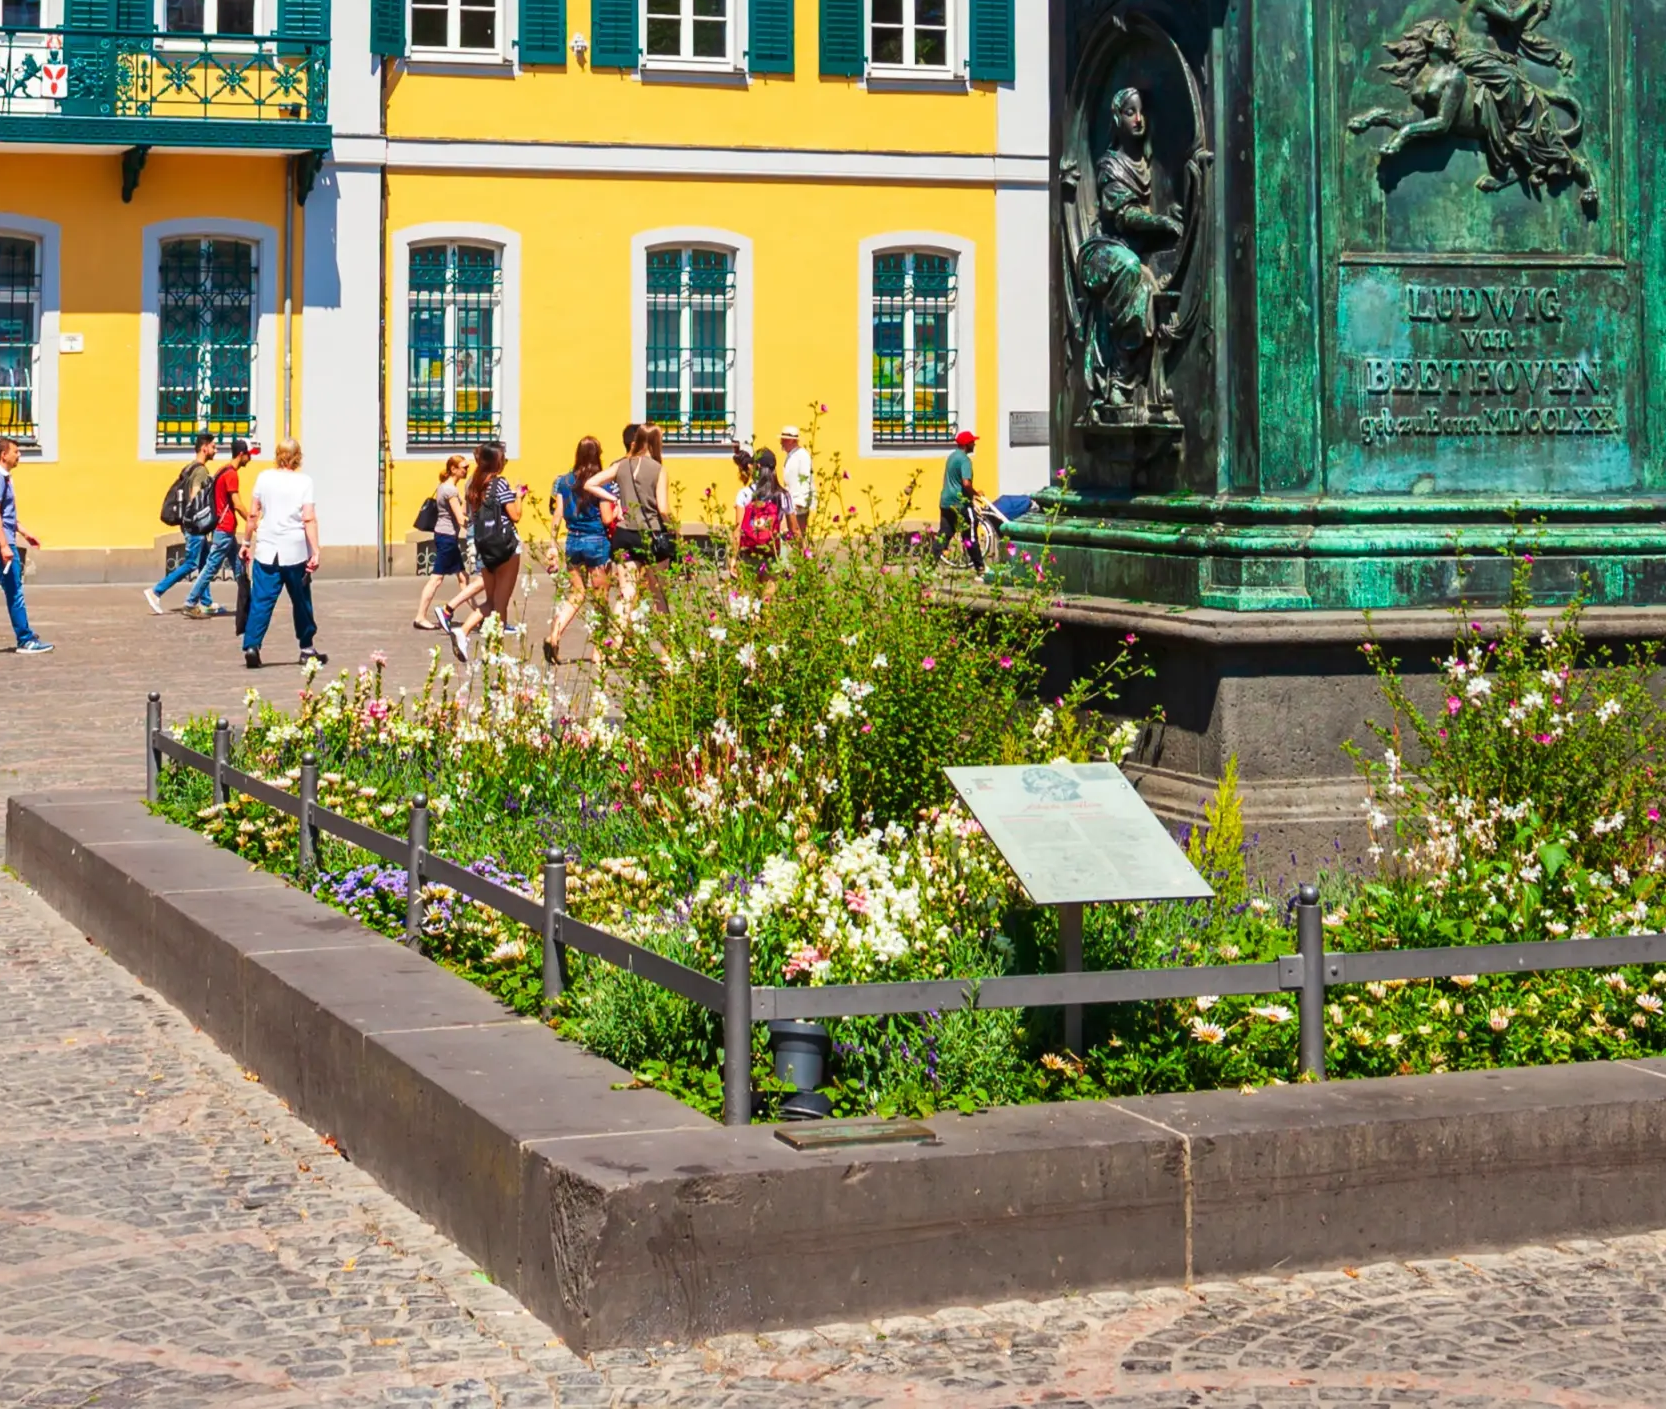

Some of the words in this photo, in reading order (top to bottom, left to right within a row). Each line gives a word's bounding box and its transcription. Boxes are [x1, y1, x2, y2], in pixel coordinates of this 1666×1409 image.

[1407, 285, 1563, 323] LUDWIG
[1461, 329, 1515, 352] van
[1364, 357, 1609, 396] BEETHOVEN.
